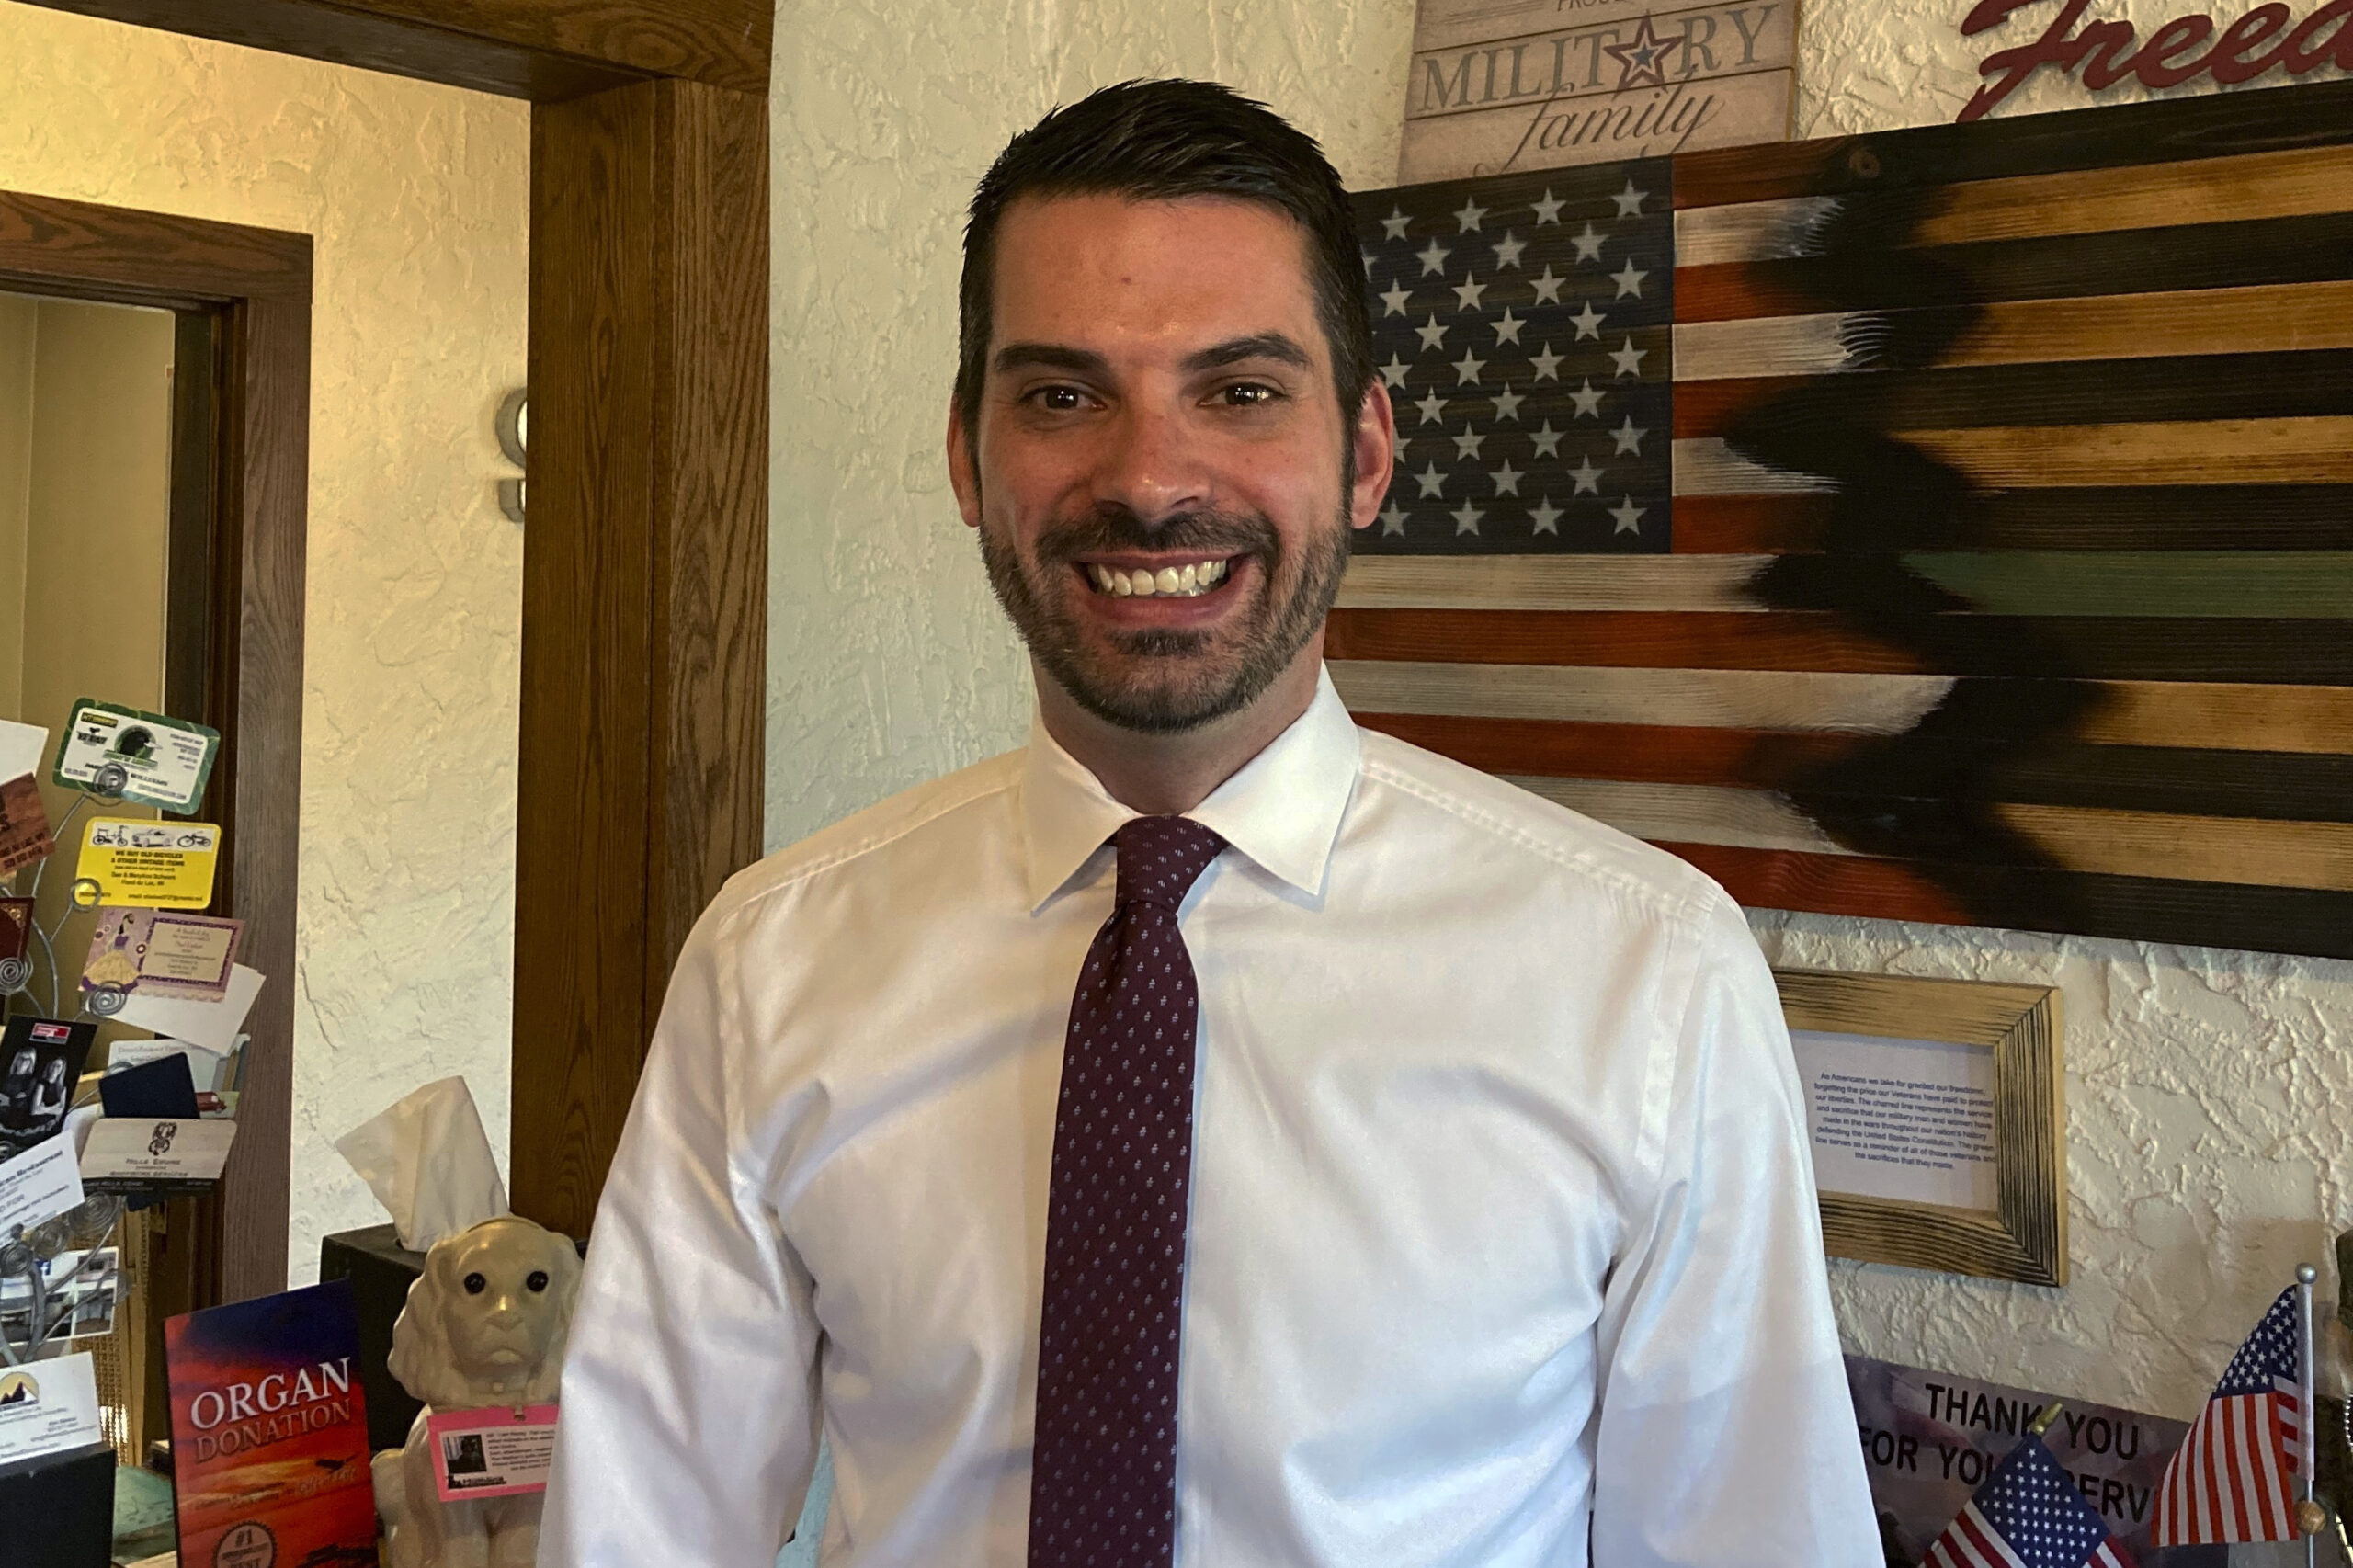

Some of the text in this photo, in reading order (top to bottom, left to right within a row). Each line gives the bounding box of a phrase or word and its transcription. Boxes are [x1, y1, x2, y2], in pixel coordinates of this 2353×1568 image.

[1489, 64, 1724, 176] family
[1814, 1083, 1846, 1094] forgetting
[1821, 1072, 1830, 1080] As
[1831, 1073, 1867, 1084] Americans
[1896, 1079, 1905, 1087] for
[1907, 1082, 1934, 1090] granted
[1872, 1100, 1899, 1108] charred
[1915, 1105, 1952, 1113] represents
[1888, 1113, 1913, 1121] military
[1817, 1126, 1849, 1137] defending
[1864, 1131, 1886, 1140] United
[1888, 1133, 1910, 1142] States
[1957, 1141, 1971, 1149] The
[1881, 1122, 1919, 1132] throughout
[1962, 1131, 1986, 1141] history
[1868, 1154, 1900, 1163] sacrifices
[1915, 1159, 1931, 1168] they
[1869, 1143, 1900, 1152] reminder
[1949, 1153, 1981, 1161] veterans
[190, 1356, 352, 1429] ORGAN
[1925, 1382, 2140, 1460] THANK YOU
[196, 1398, 351, 1464] DONATION
[1938, 1443, 1995, 1486] YO
[235, 1528, 253, 1548] #1
